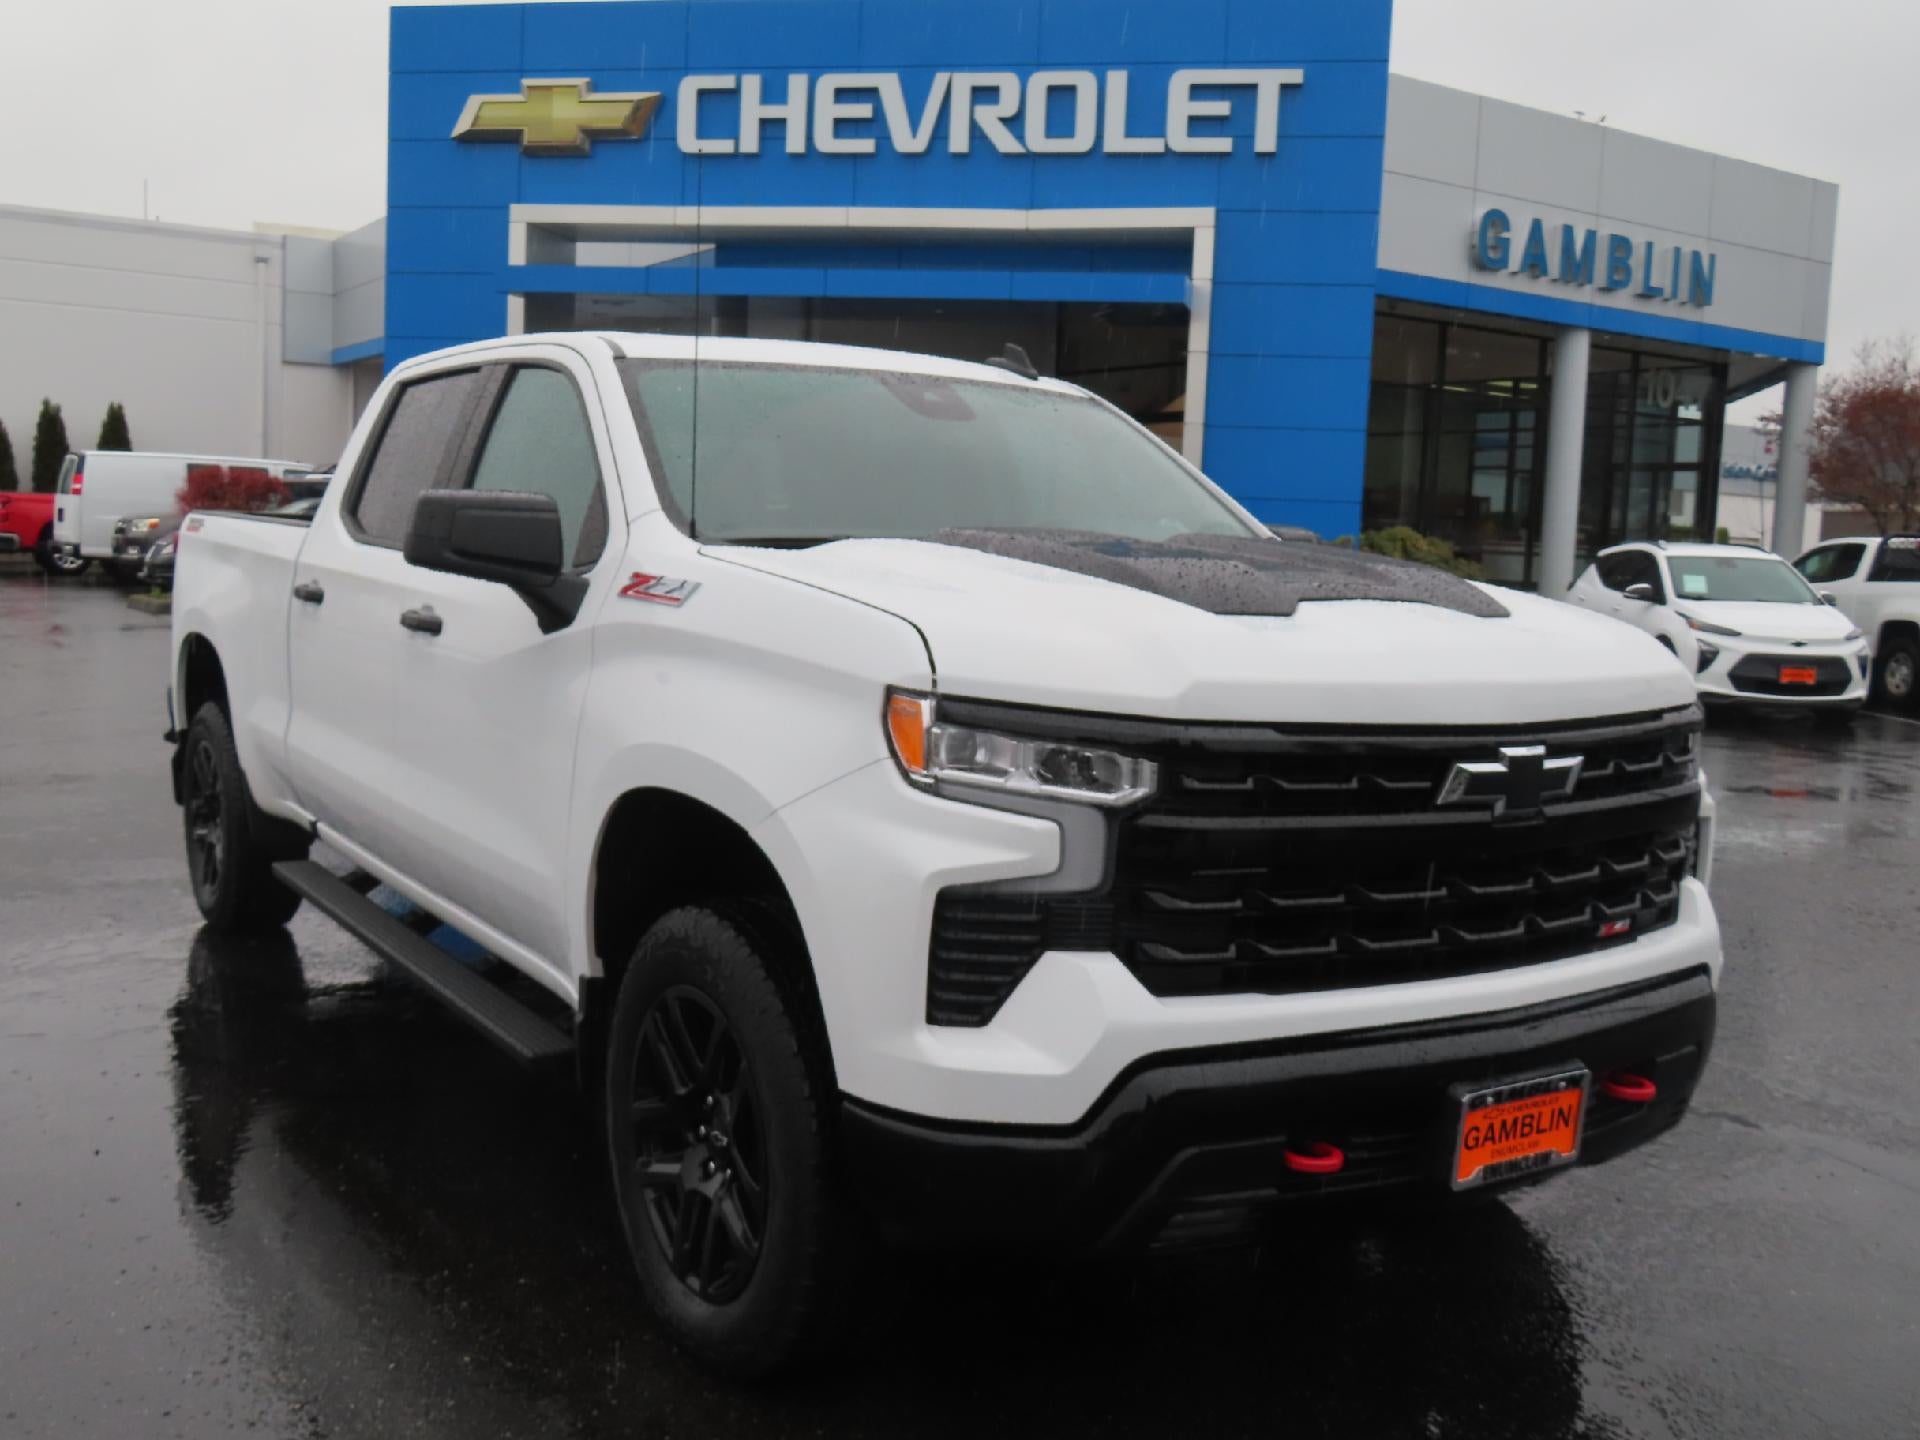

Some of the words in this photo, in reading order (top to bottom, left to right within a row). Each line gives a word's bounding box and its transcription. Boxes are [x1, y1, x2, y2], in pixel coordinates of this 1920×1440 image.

[677, 68, 1305, 156] CHEVROLET
[1474, 207, 1717, 308] GAMBLIN
[1464, 1103, 1572, 1151] GAMBLIN
